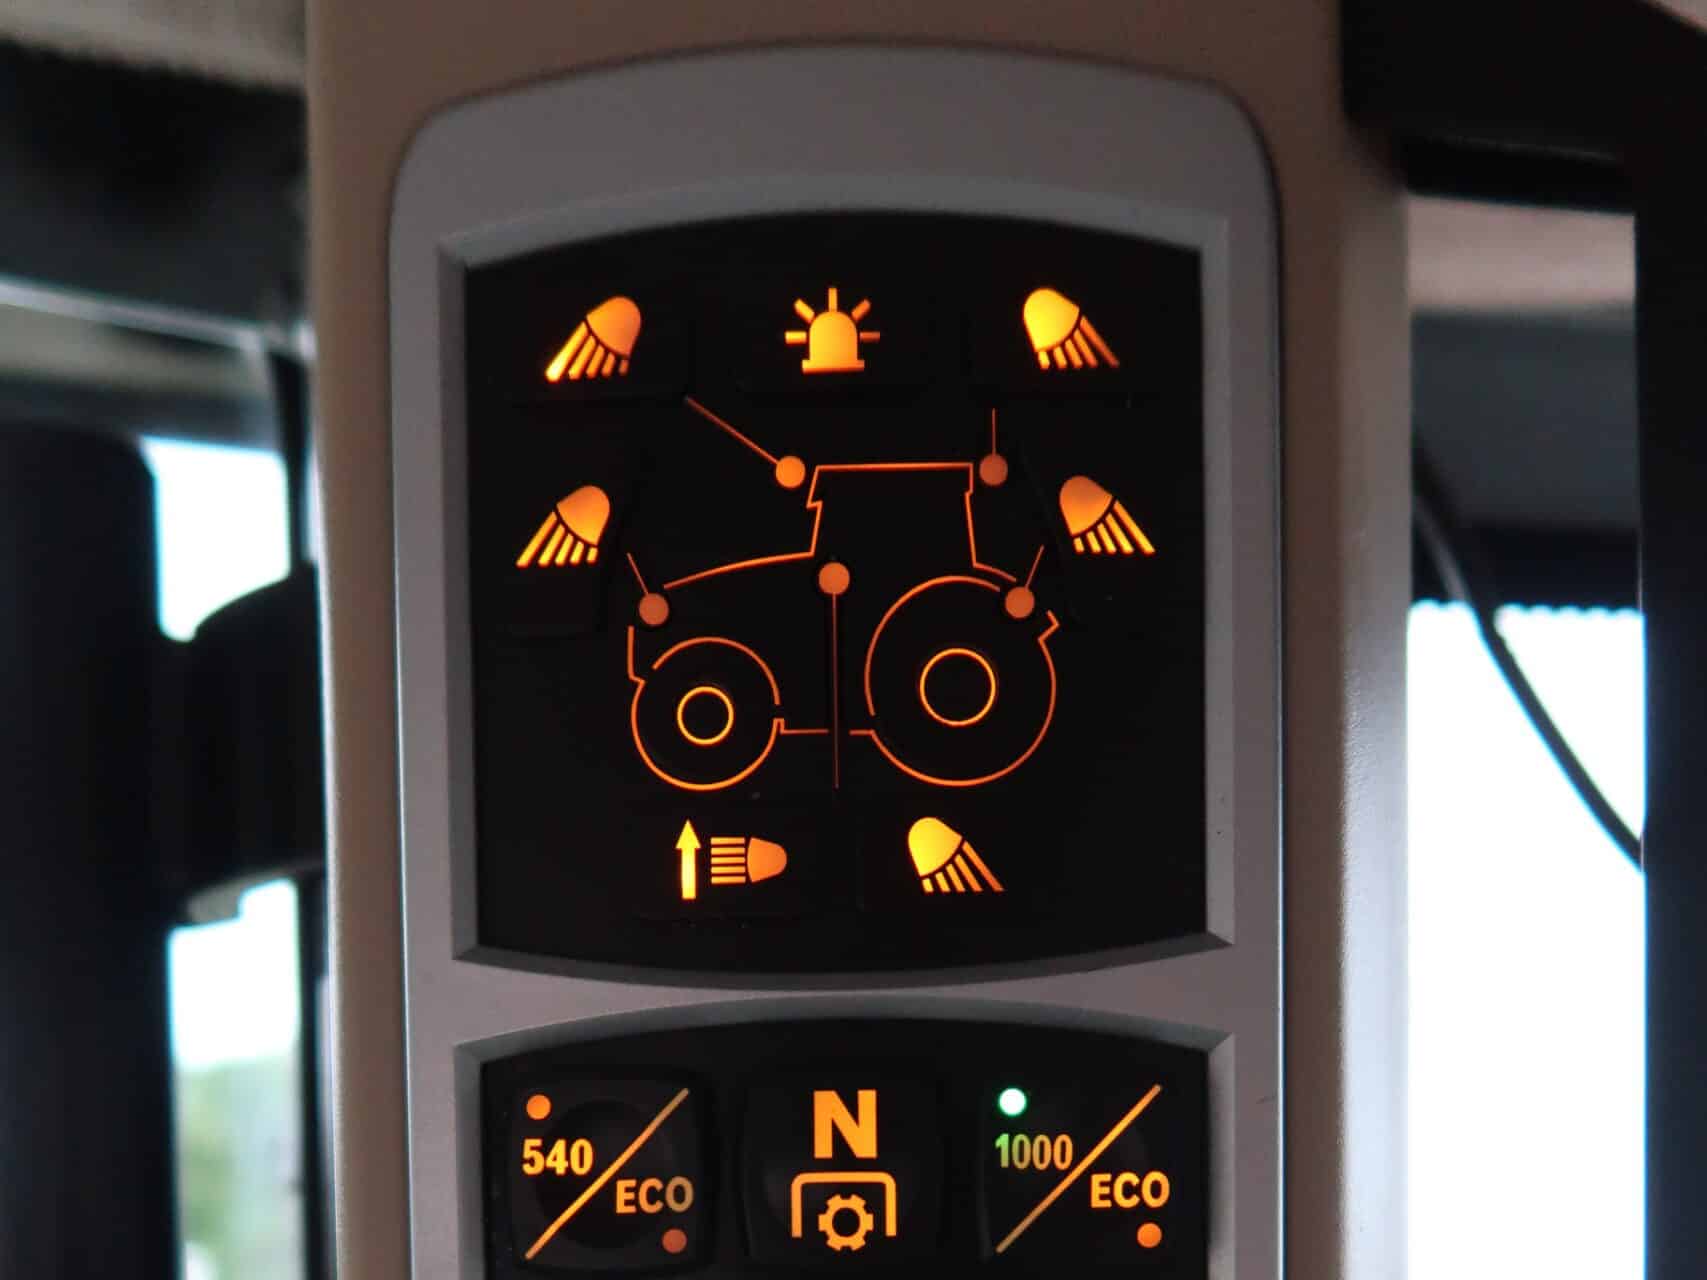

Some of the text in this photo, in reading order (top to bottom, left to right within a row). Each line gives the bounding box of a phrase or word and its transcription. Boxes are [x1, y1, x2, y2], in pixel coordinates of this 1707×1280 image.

[813, 1089, 878, 1159] N
[522, 1138, 594, 1176] 540
[994, 1133, 1073, 1171] 1000
[615, 1177, 694, 1214] ECO
[1090, 1171, 1170, 1208] ECO
